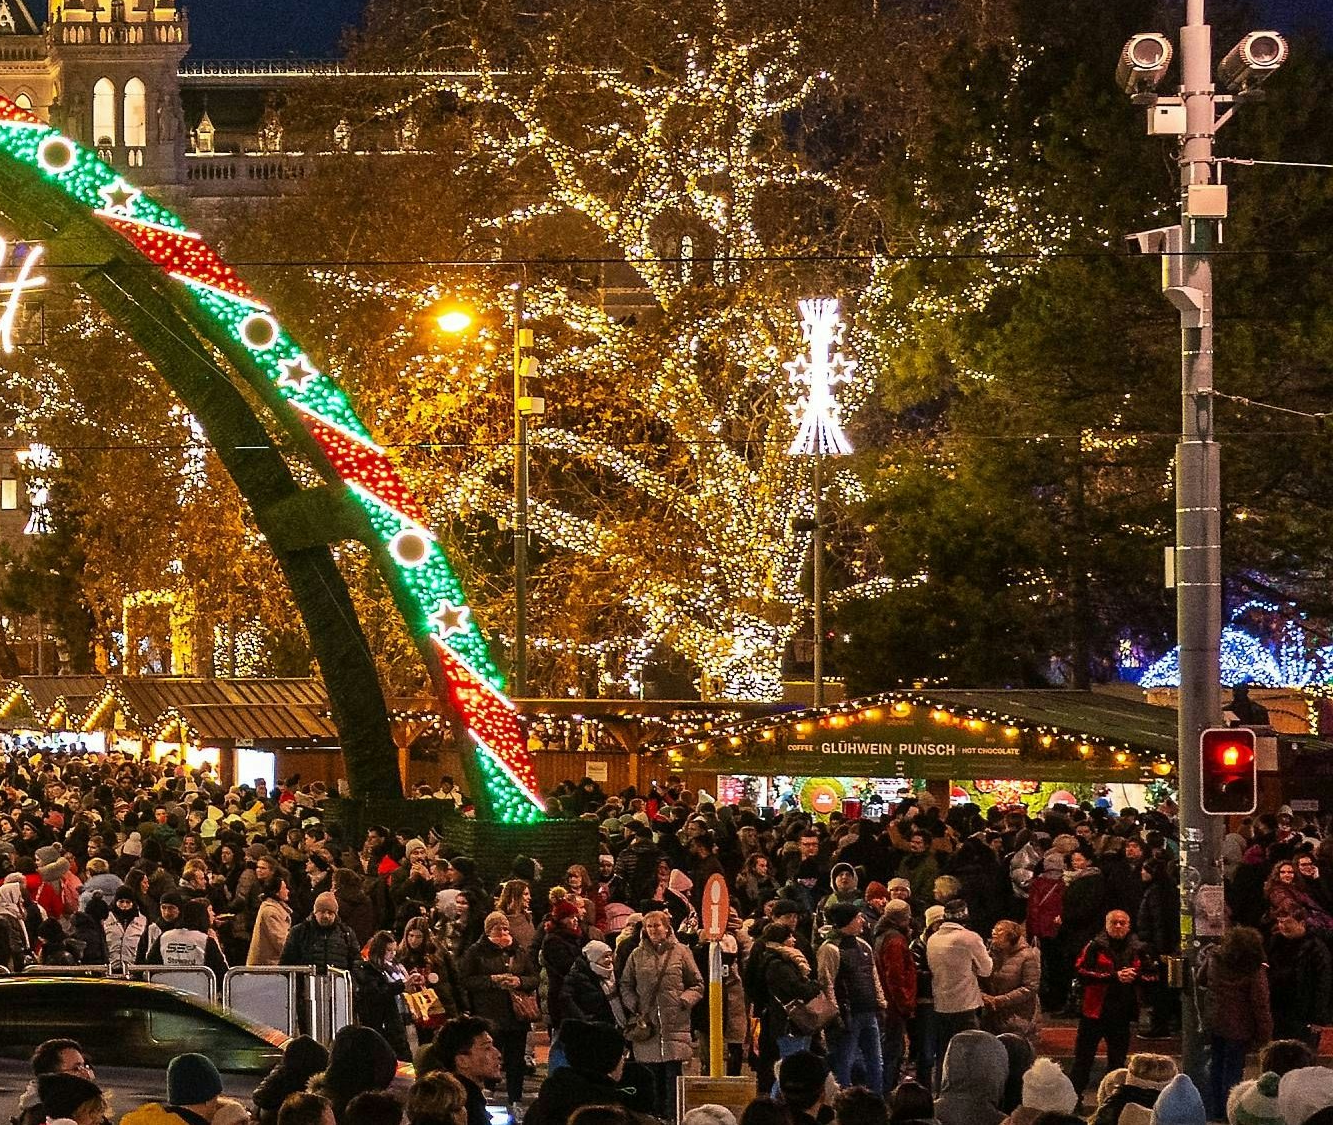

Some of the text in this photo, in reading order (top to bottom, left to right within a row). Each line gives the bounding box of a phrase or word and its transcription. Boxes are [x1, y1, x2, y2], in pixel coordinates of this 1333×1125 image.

[787, 744, 814, 752] COFFEE
[821, 740, 892, 755] GLÜHWEIN
[899, 743, 956, 756] PUNSCH
[978, 747, 1020, 755] CHOCOLATE
